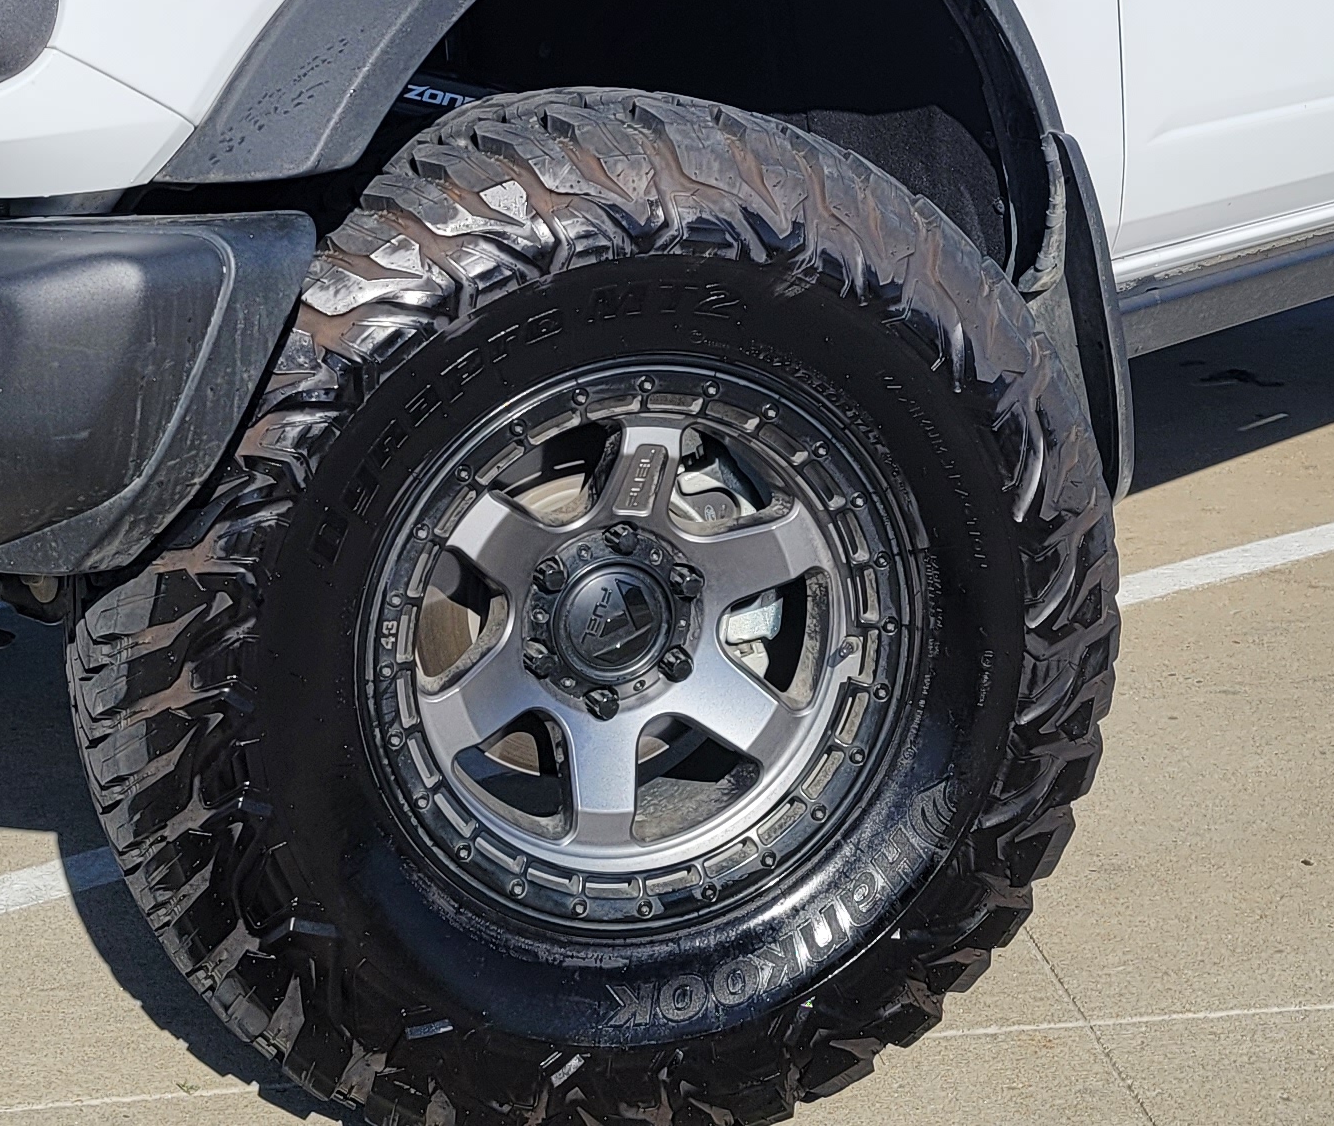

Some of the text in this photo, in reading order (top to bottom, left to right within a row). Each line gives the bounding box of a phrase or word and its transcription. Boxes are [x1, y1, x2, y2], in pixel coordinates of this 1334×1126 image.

[626, 448, 656, 507] FUEL
[380, 620, 398, 650] 43
[580, 586, 613, 644] FUEL
